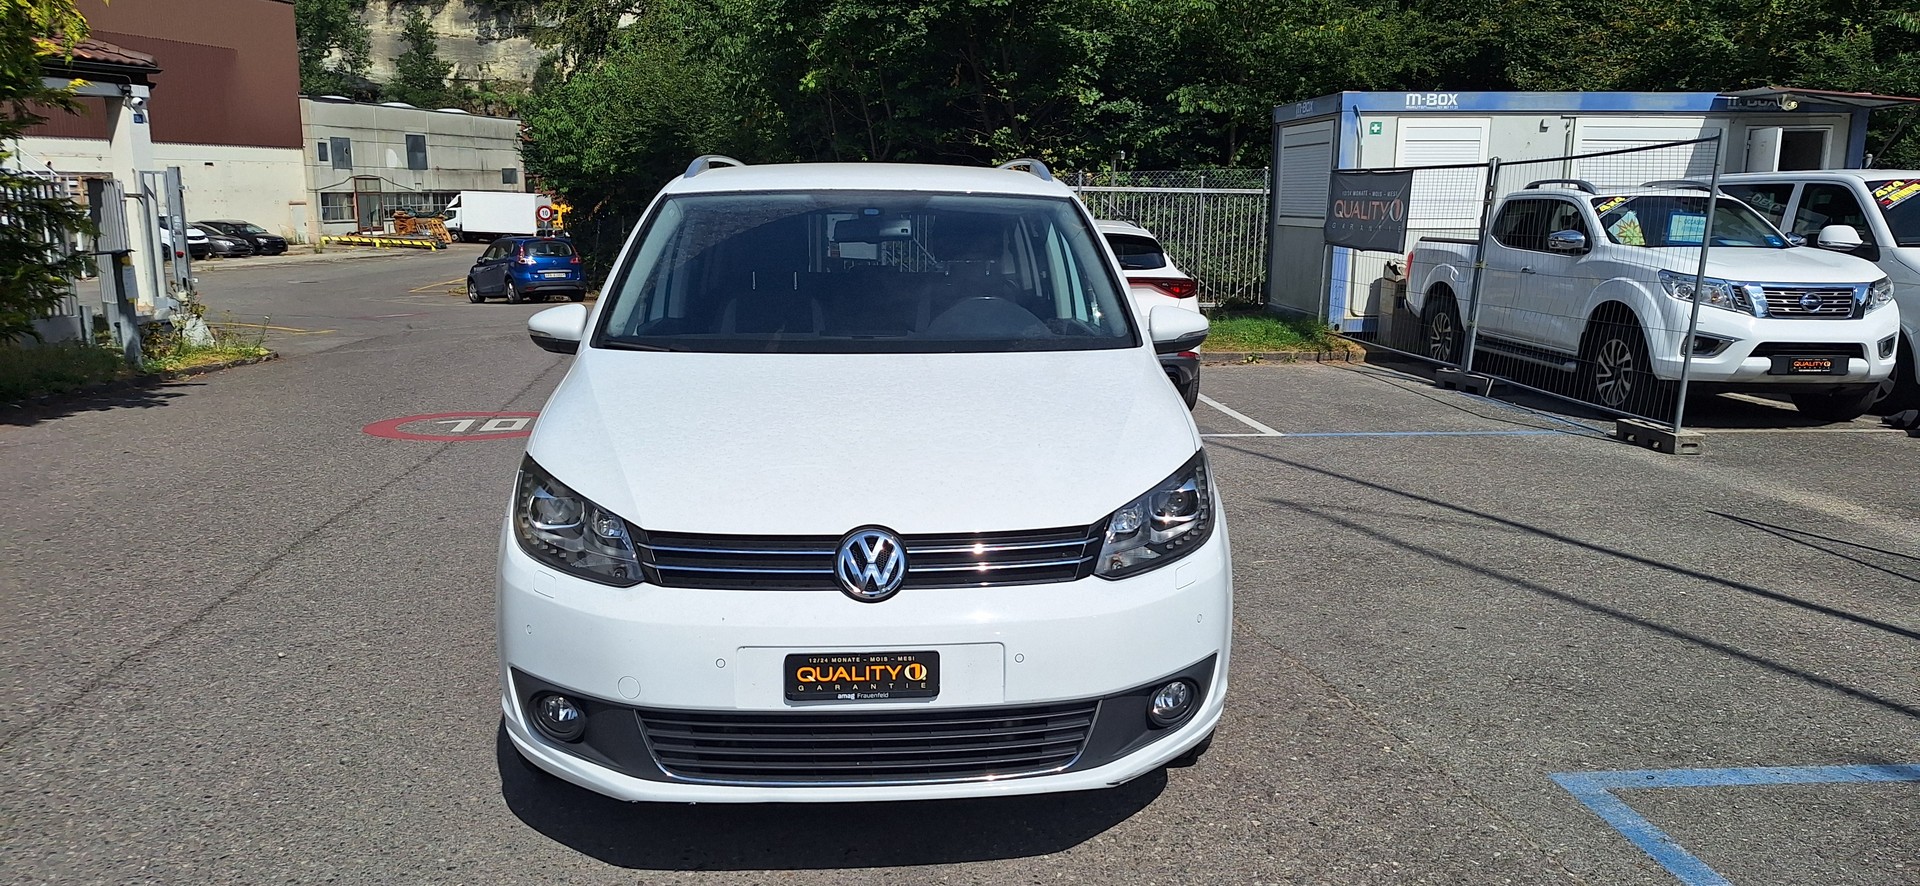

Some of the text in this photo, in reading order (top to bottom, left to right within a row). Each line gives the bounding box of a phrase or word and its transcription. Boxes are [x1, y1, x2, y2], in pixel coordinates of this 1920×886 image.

[541, 209, 549, 217] 10
[1334, 200, 1390, 220] QUALITY
[796, 664, 903, 683] QUALITY
[797, 682, 926, 692] GARANTIE
